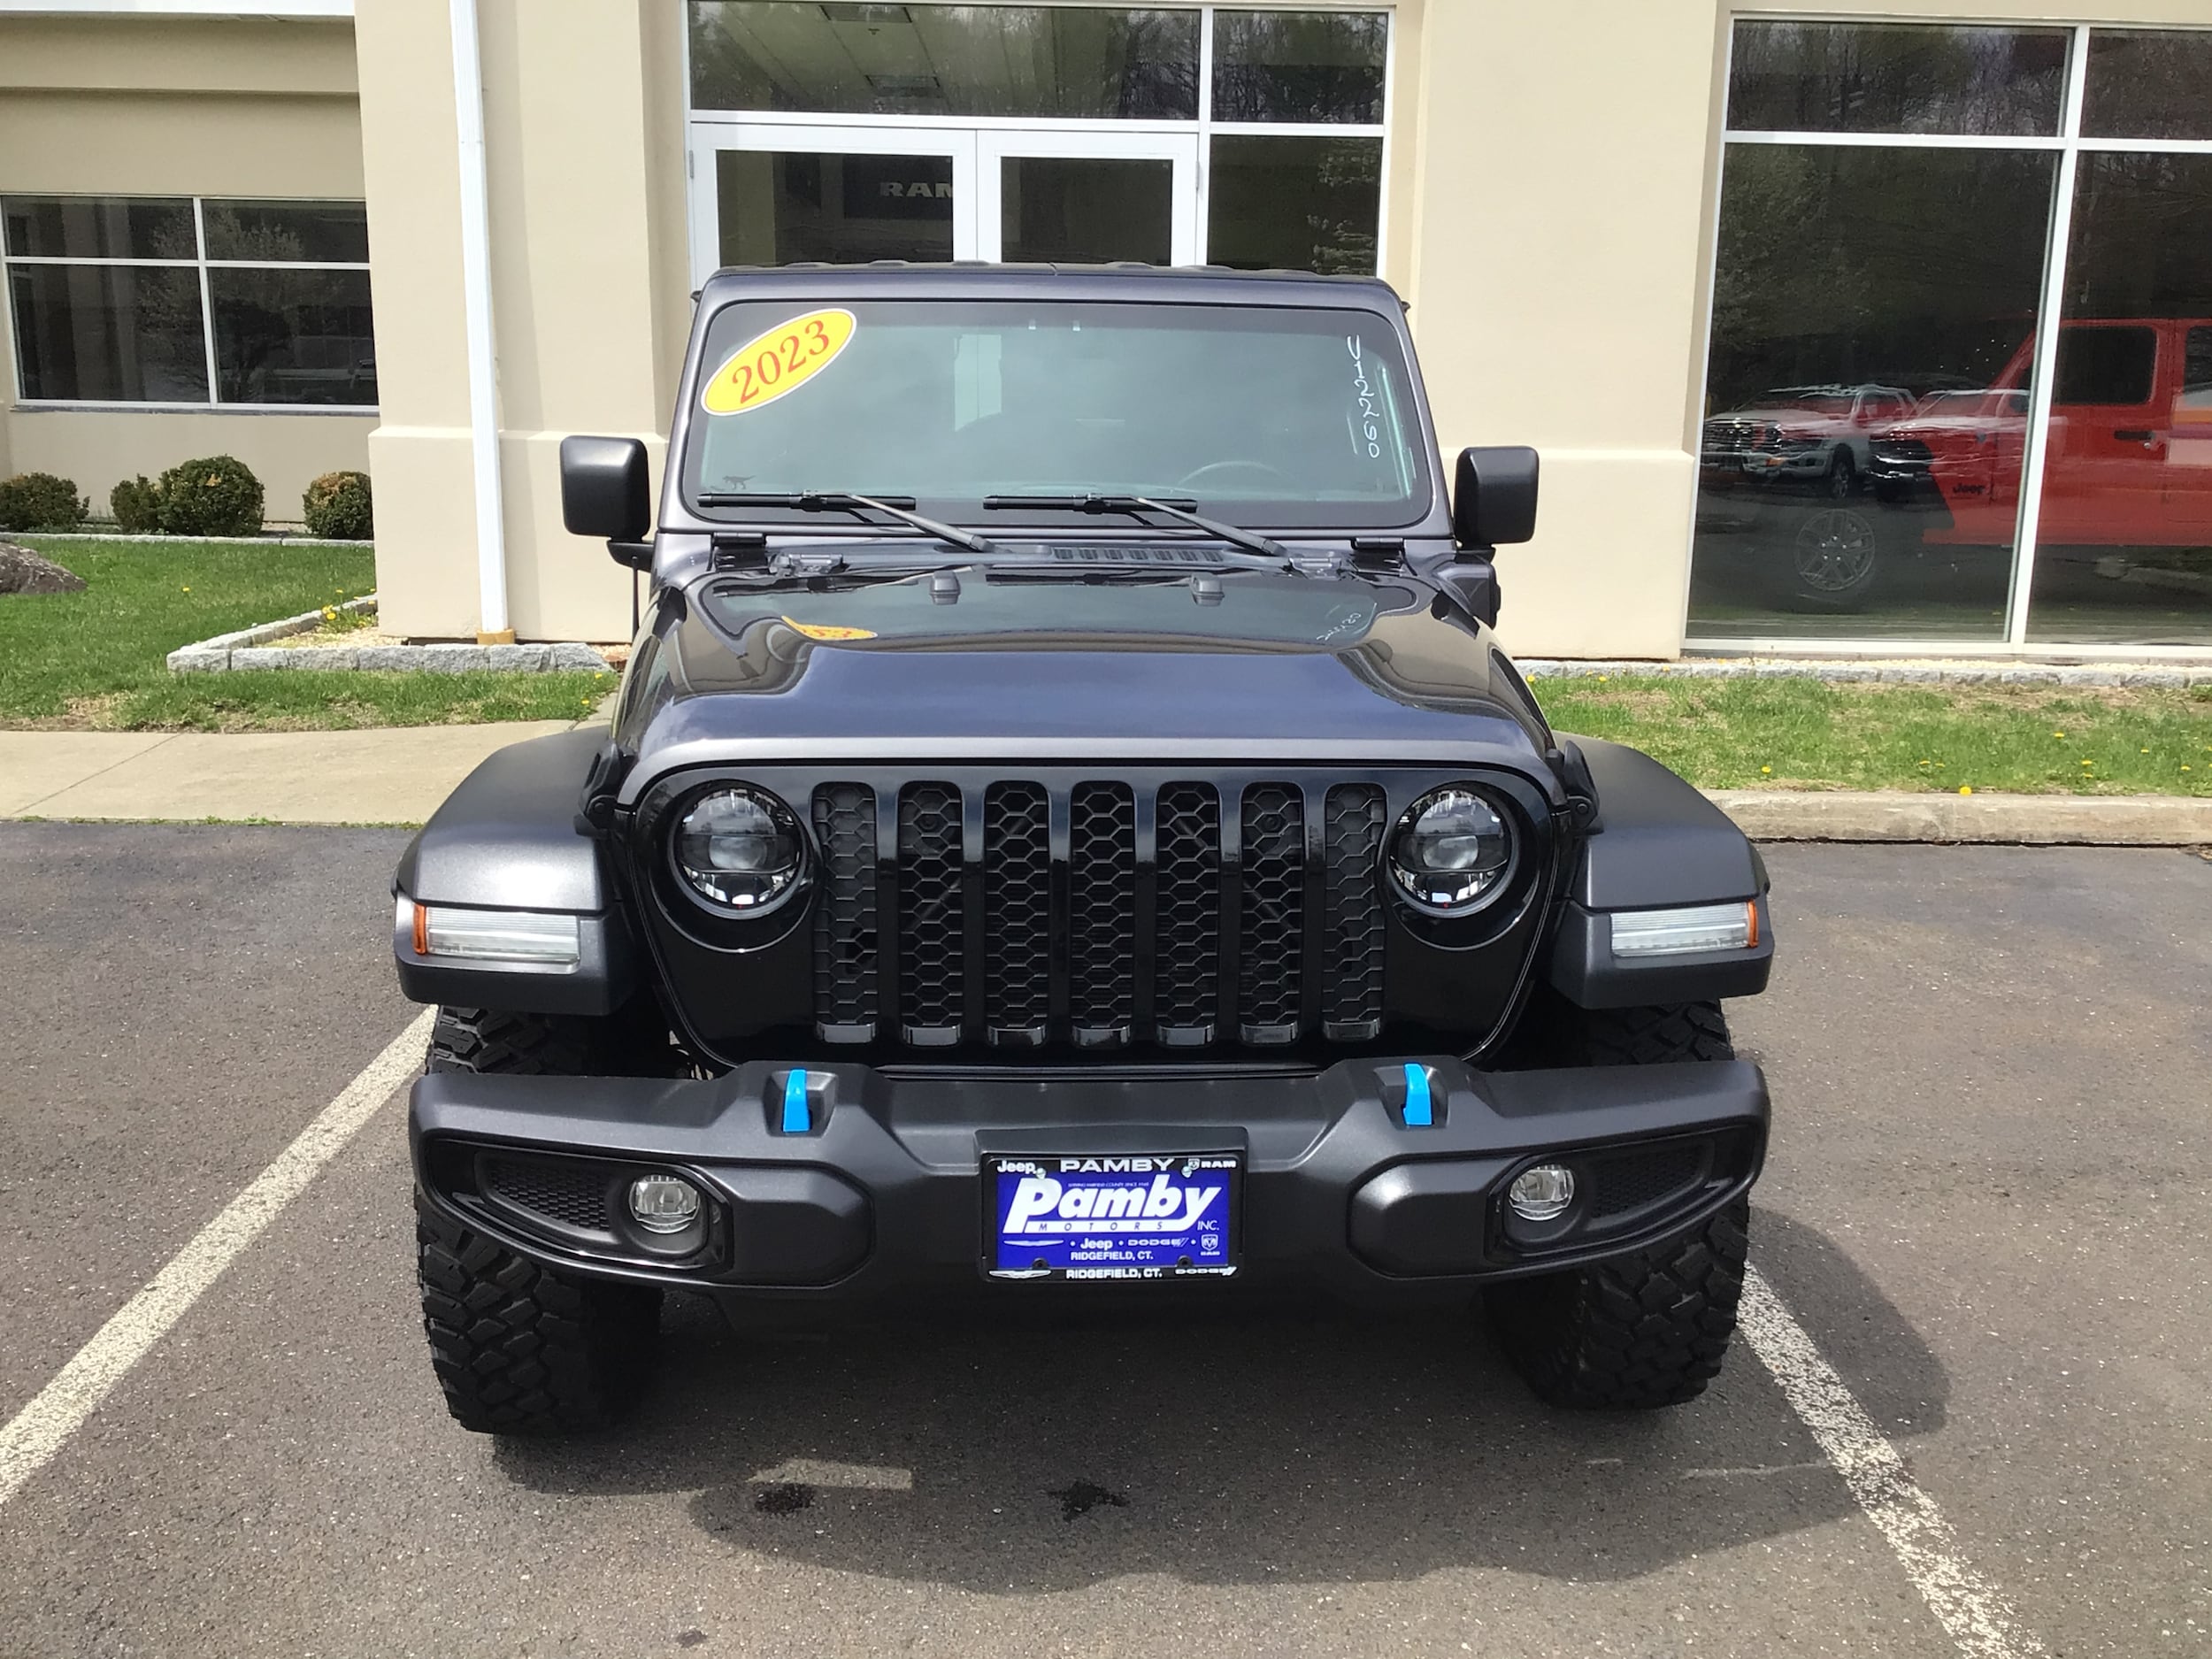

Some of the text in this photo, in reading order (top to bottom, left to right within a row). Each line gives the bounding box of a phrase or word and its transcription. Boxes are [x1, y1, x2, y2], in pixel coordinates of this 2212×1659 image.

[733, 320, 829, 403] 2023
[1060, 1158, 1174, 1172] PAMBY
[1002, 1174, 1221, 1233] Pamby
[1039, 1222, 1163, 1231] MOTORS
[1197, 1220, 1219, 1231] INC.
[1080, 1238, 1113, 1250] Jeep
[1070, 1250, 1154, 1261] RIDGEFIELD, CT.
[1066, 1268, 1163, 1279] RIDGEFIELD, CT.
